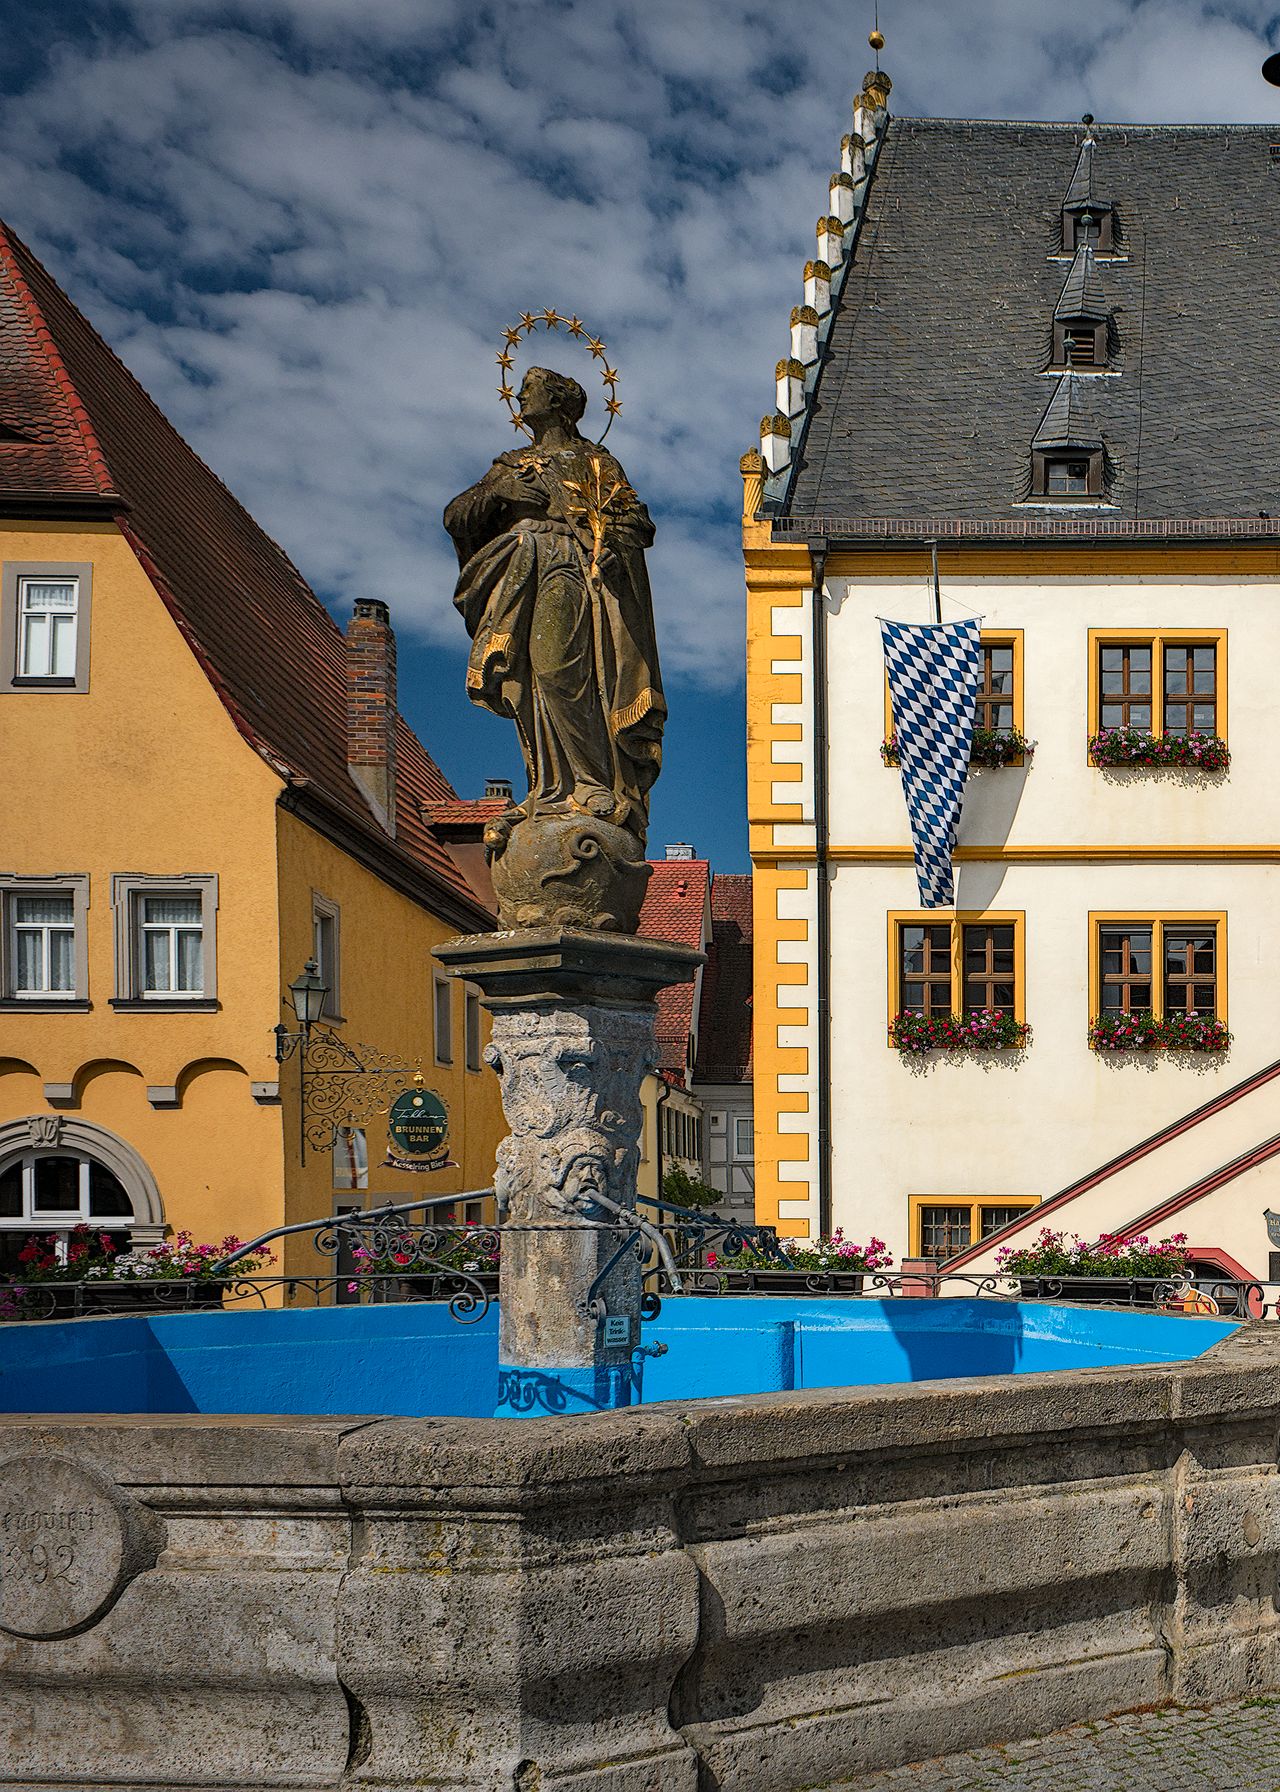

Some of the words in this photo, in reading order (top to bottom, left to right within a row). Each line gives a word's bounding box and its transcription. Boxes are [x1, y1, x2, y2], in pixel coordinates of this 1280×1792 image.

[395, 1125, 443, 1133] BRUNNEN
[392, 1160, 430, 1172] Kesselring
[430, 1160, 445, 1169] Bier
[610, 1319, 625, 1327] Kein
[0, 1543, 80, 1586] 892
